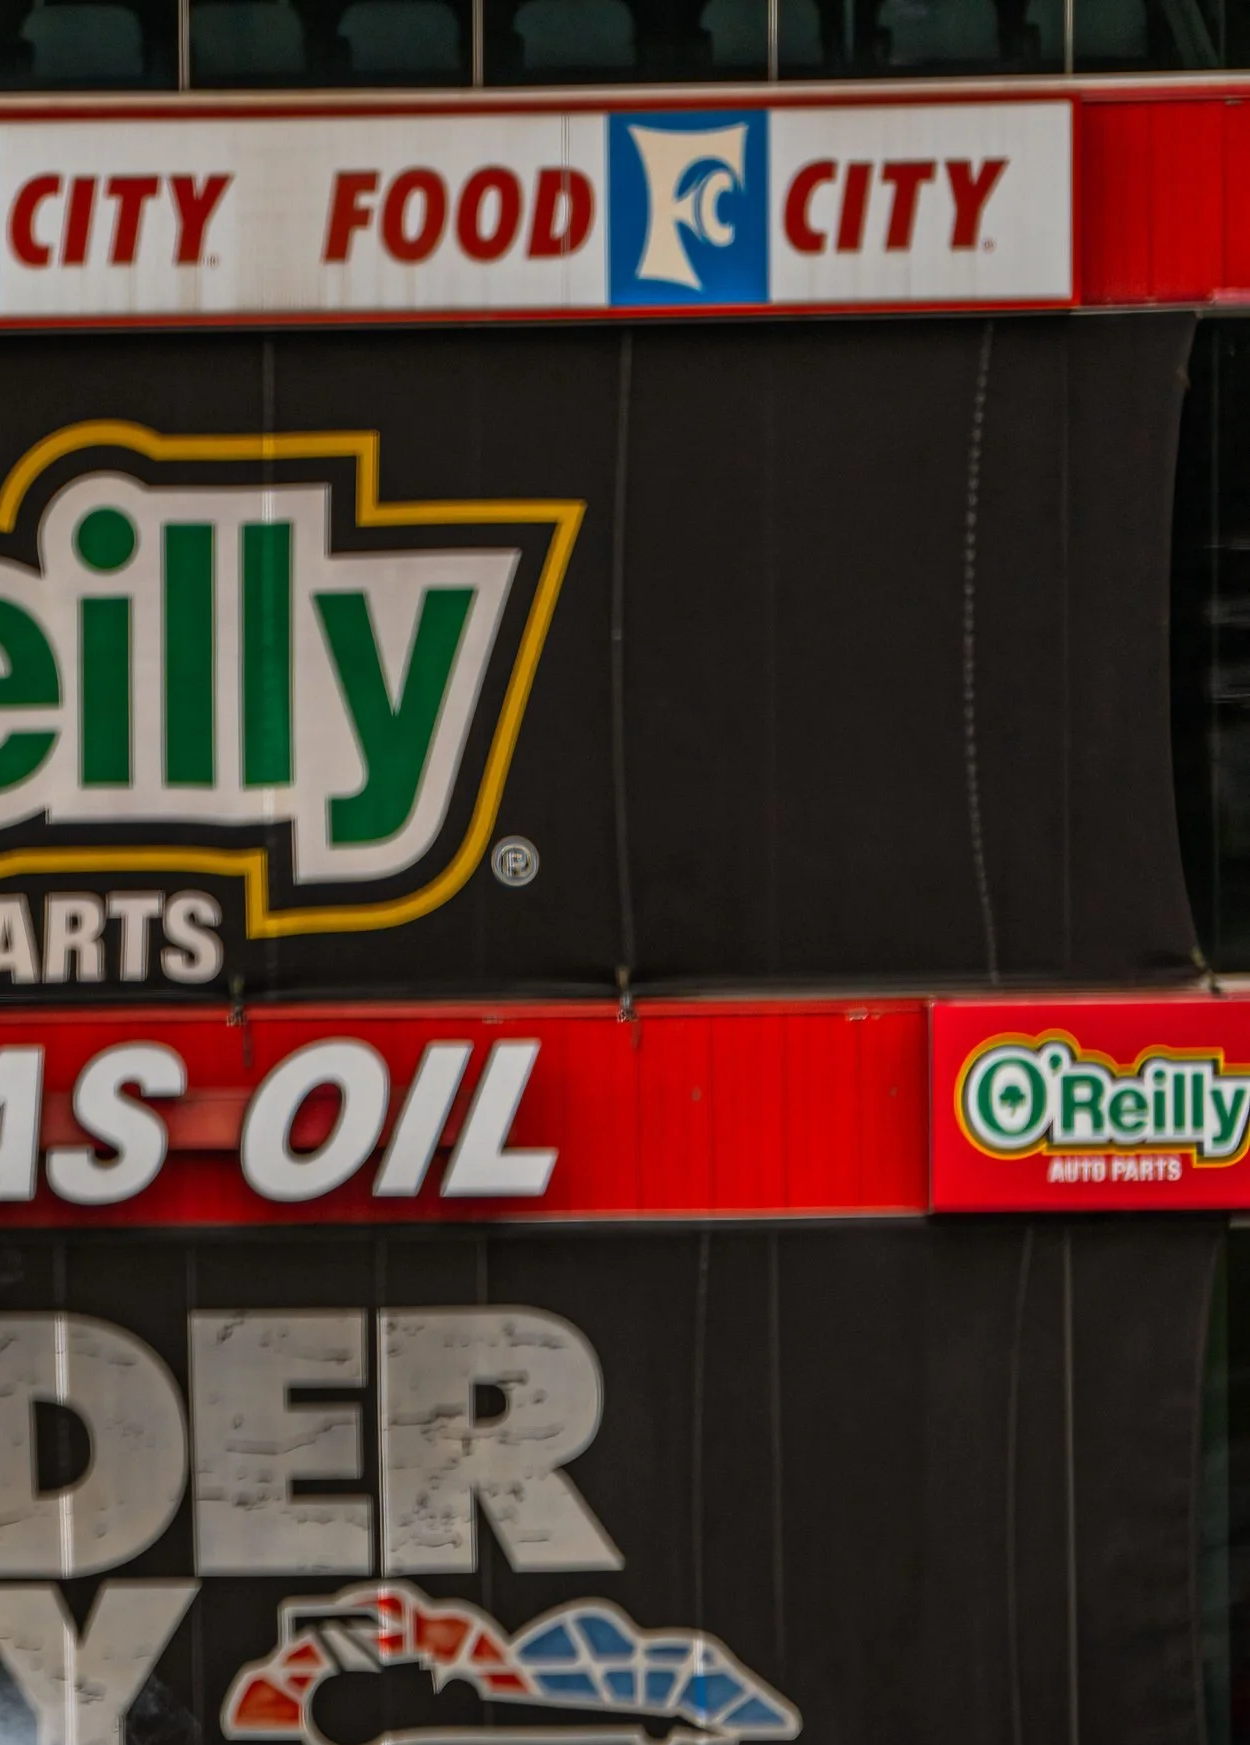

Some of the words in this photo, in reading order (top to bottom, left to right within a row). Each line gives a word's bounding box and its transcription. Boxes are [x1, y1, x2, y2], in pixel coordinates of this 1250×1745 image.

[8, 173, 233, 268] CITY
[323, 166, 596, 264] FOOD
[782, 158, 1009, 254] CITY
[240, 1036, 560, 1203] OIL
[976, 1053, 1246, 1145] O'Reilly
[1047, 1156, 1106, 1183] AUTO
[1111, 1154, 1183, 1183] PARTS
